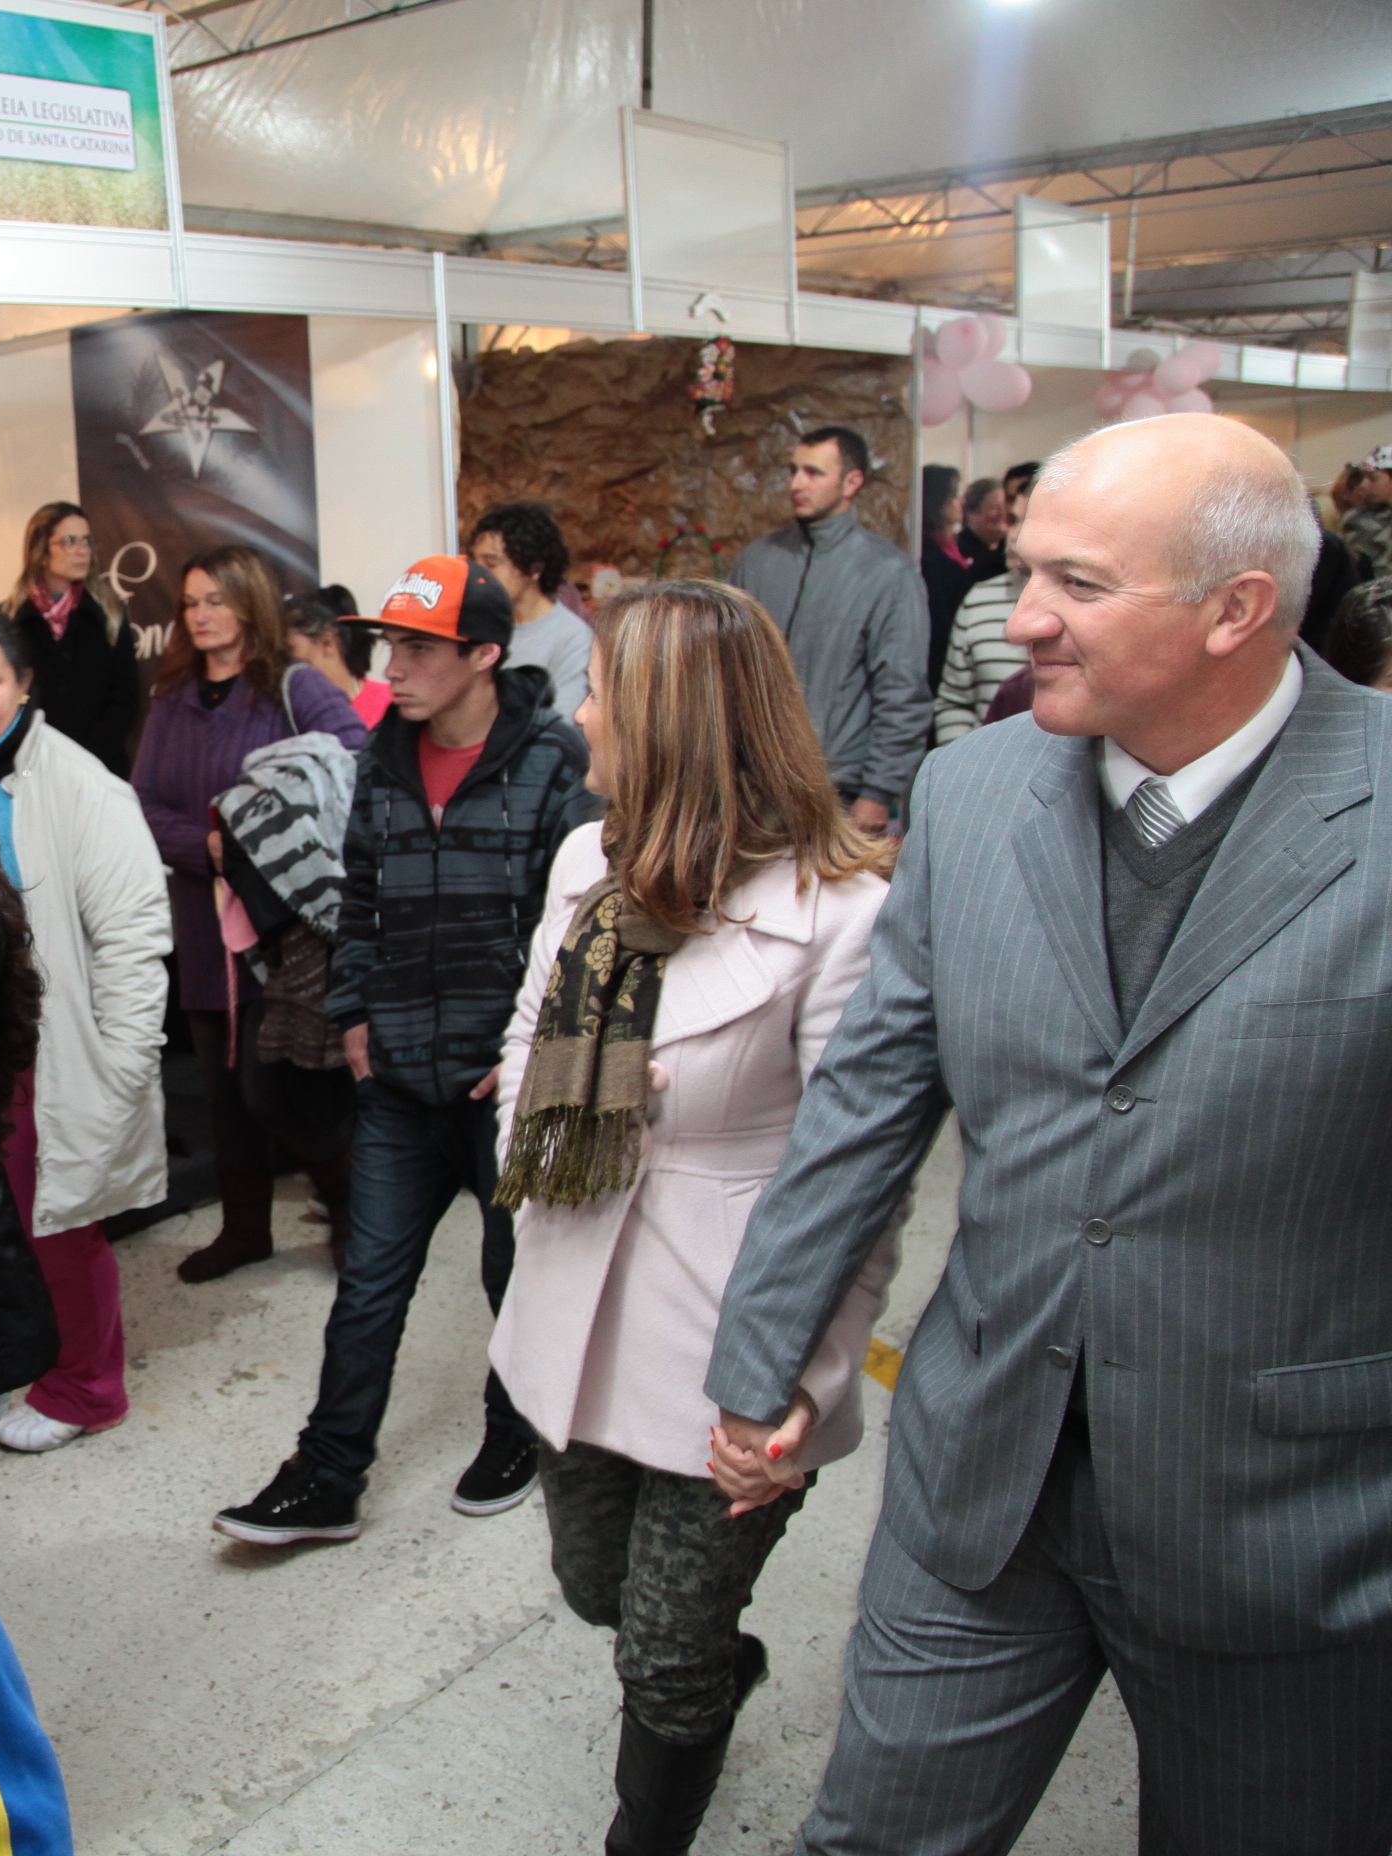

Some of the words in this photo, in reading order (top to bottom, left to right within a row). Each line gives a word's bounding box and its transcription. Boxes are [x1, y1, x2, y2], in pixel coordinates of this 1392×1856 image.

[32, 99, 129, 129] LEGISLATIVA
[7, 128, 24, 144] DE
[29, 131, 70, 148] SANTA
[70, 136, 132, 155] CATARINA
